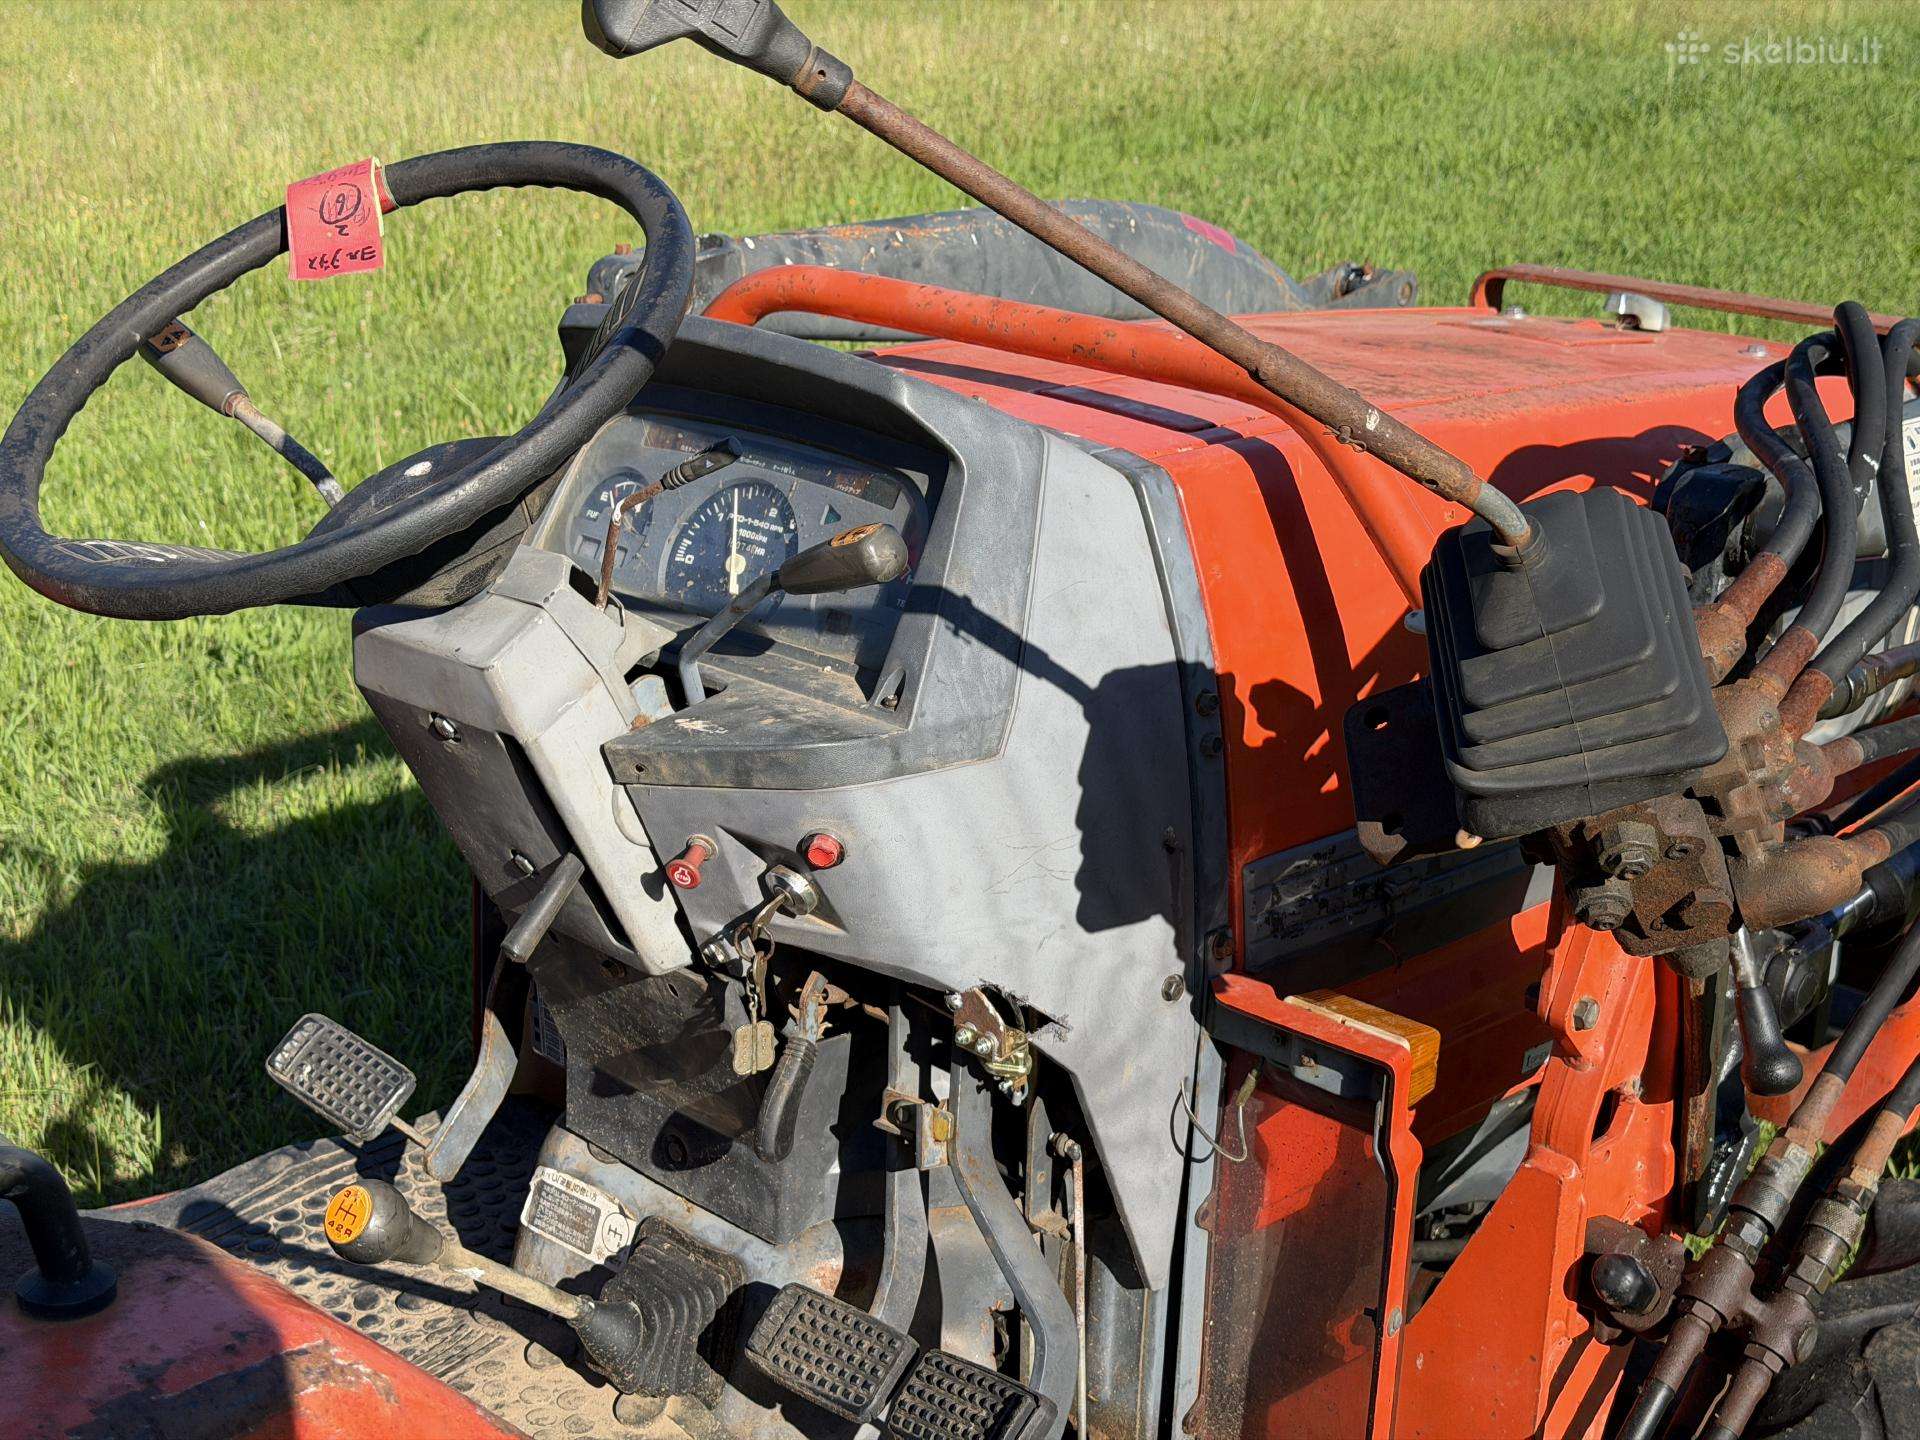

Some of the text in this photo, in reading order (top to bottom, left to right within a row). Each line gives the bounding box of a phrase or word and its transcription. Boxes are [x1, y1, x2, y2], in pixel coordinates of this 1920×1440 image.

[769, 507, 778, 517] 2
[343, 1189, 352, 1198] 3
[328, 1219, 353, 1237] 4 2 R
